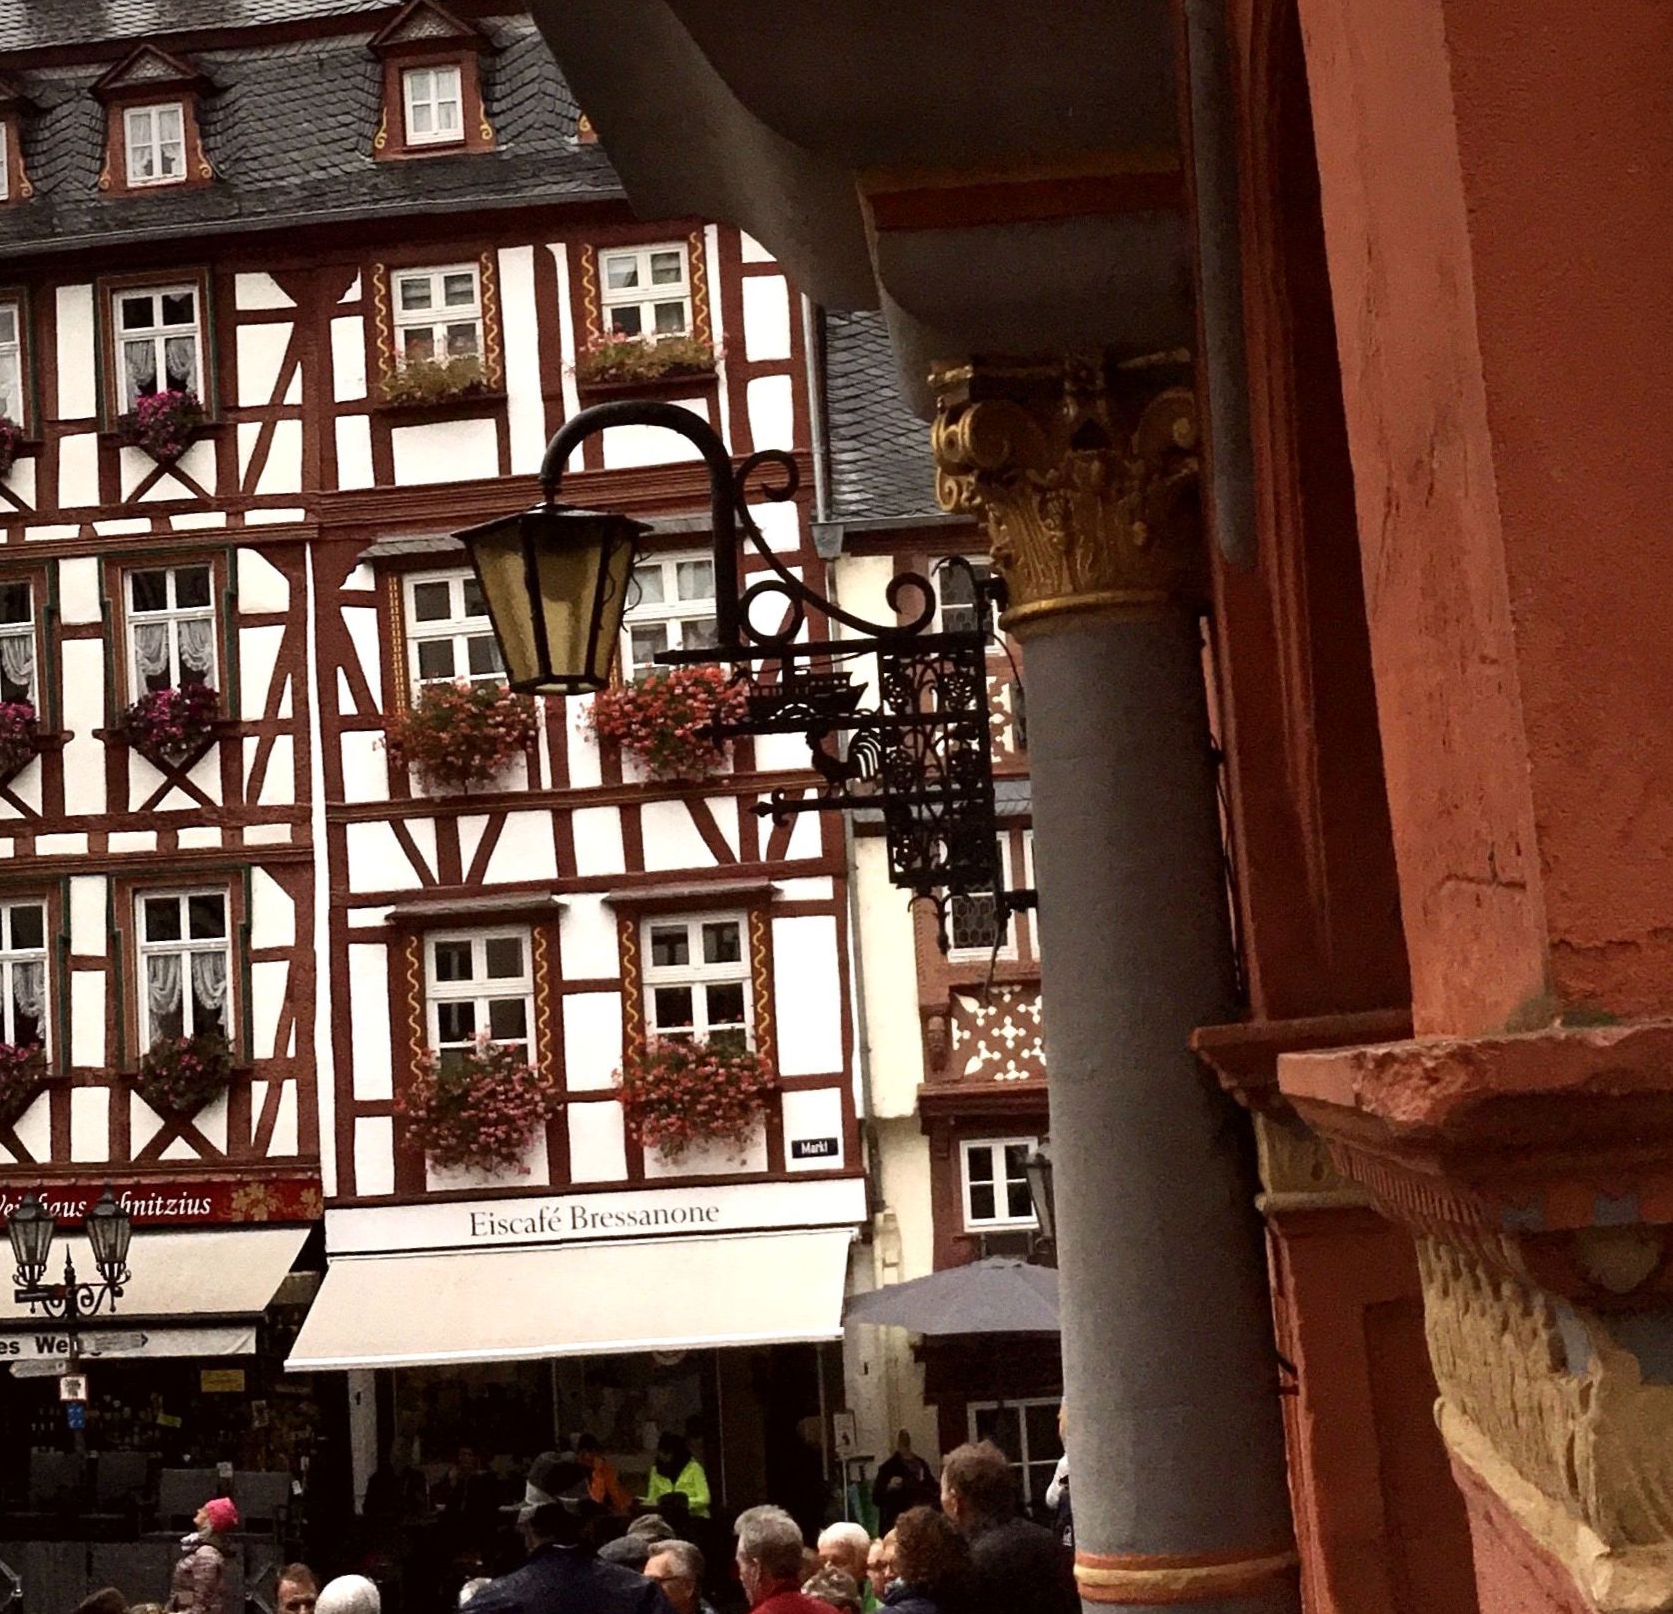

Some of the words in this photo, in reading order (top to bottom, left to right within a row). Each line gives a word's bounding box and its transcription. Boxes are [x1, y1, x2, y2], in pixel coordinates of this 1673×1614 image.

[116, 1190, 212, 1216] hnitzius
[469, 1205, 562, 1237] Eiscafé
[570, 1204, 720, 1231] Bressanone
